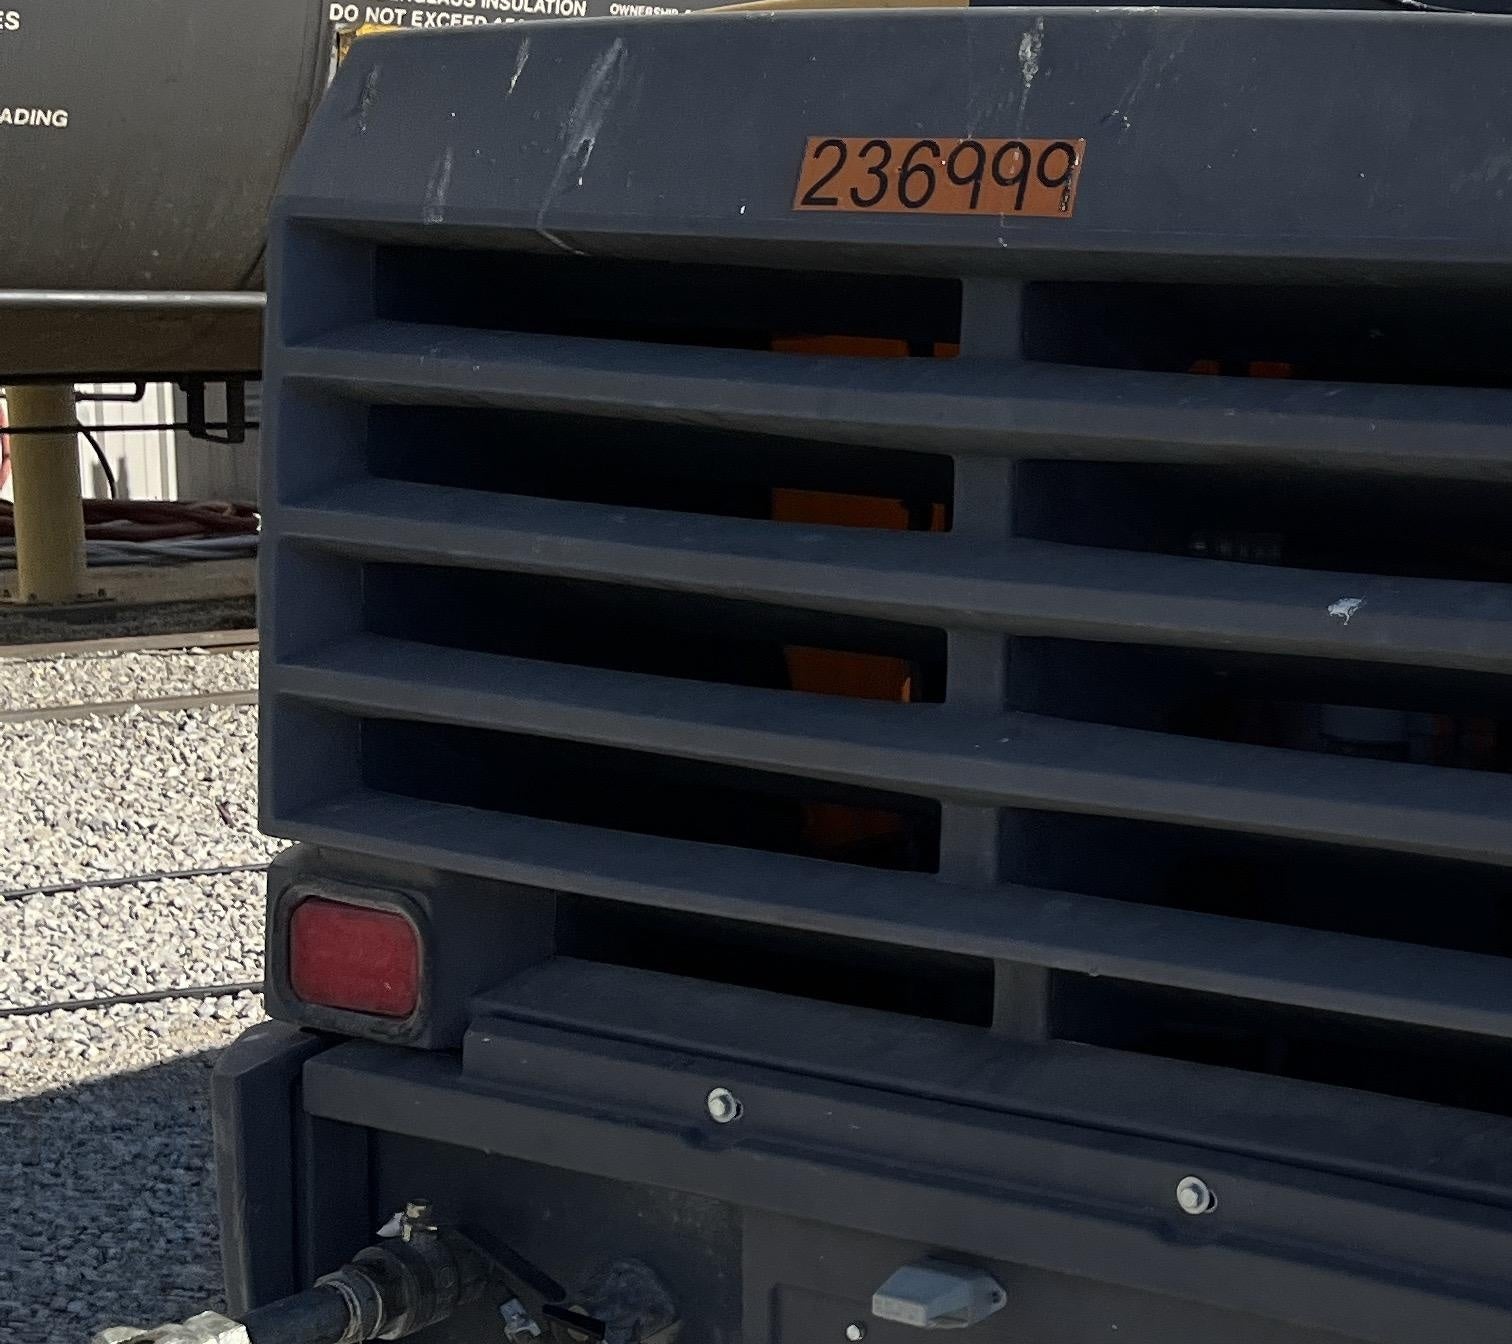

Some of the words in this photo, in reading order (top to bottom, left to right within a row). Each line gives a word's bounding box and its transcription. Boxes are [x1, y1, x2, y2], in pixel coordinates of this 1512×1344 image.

[329, 3, 359, 22] DO
[365, 6, 406, 25] NOT
[800, 139, 1077, 212] 236999
